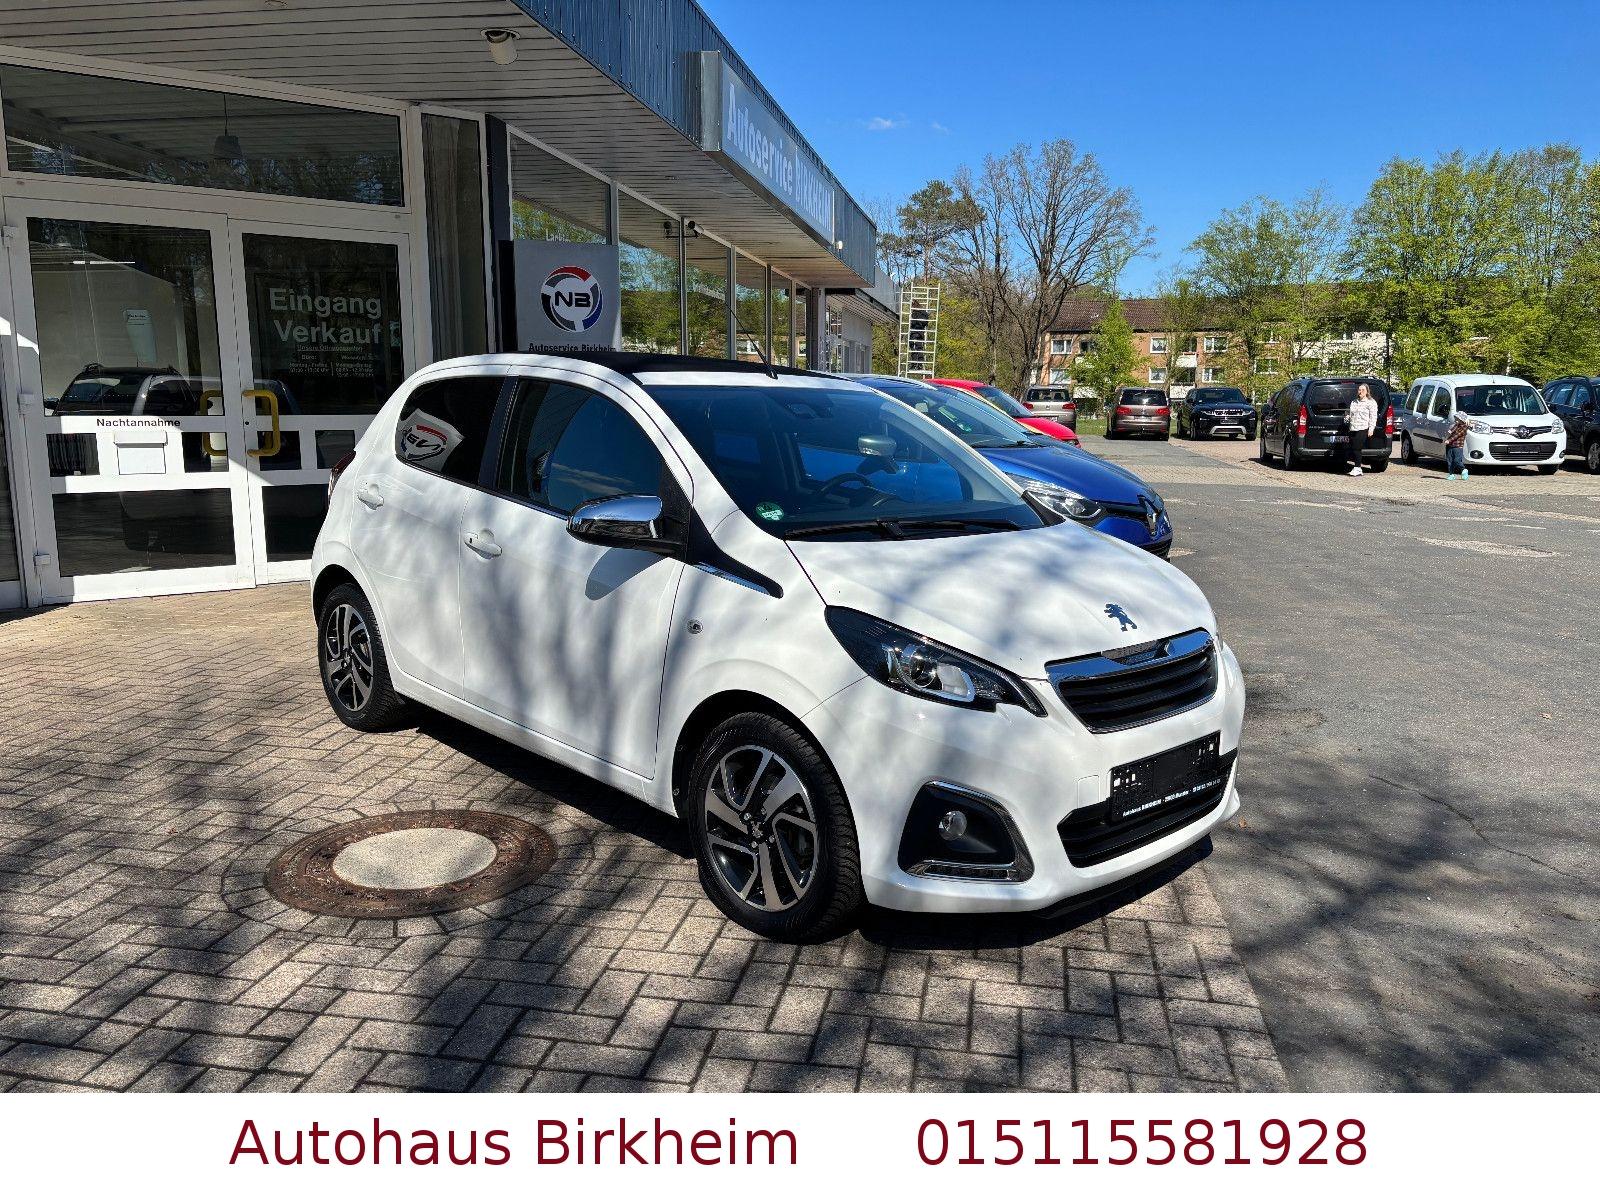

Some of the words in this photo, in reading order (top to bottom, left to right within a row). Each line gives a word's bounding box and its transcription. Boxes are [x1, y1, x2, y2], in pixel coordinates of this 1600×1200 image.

[727, 83, 793, 196] Autoservice
[269, 287, 382, 320] Eingang
[554, 291, 592, 308] NB
[273, 319, 382, 344] Verkauf
[528, 342, 579, 352] Autoservice
[96, 418, 181, 427] Nachtannahme
